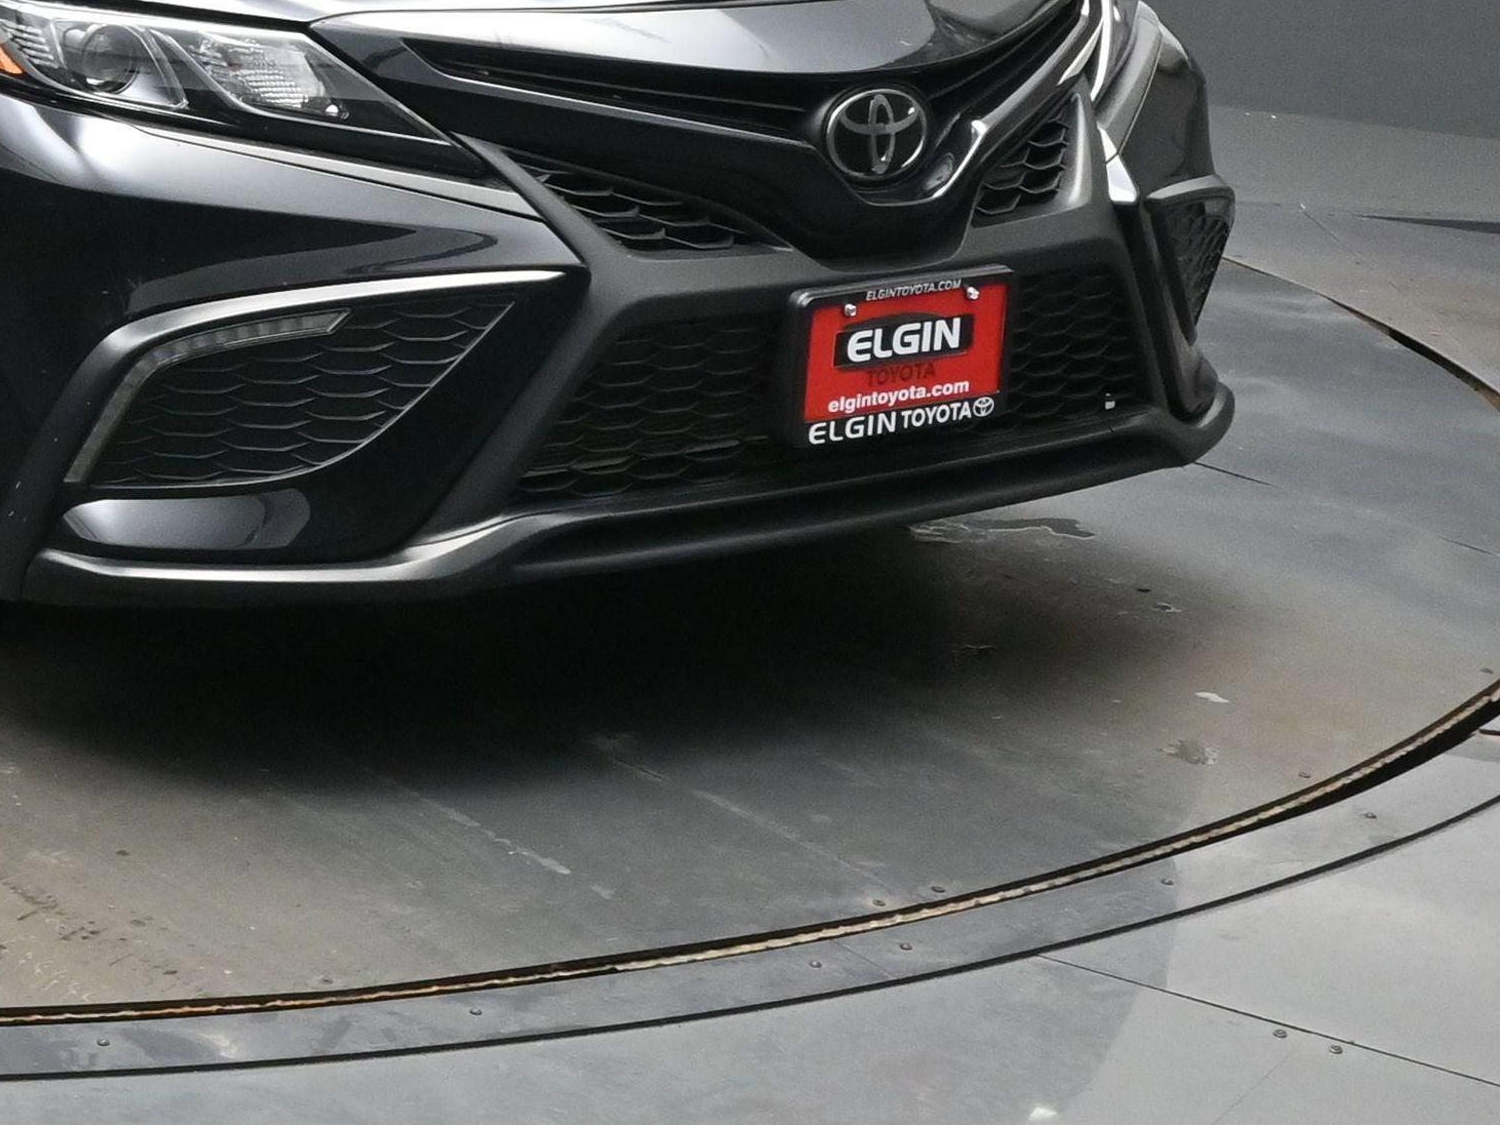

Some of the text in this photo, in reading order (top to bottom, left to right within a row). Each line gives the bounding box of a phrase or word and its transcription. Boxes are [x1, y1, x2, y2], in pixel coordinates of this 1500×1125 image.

[865, 279, 961, 301] ELGINTOYOTA.COM
[847, 317, 961, 362] ELGIN
[867, 363, 936, 386] TOYOTA
[828, 380, 970, 413] elgintoyota.com
[808, 401, 972, 445] ELGIN TOYOTA
